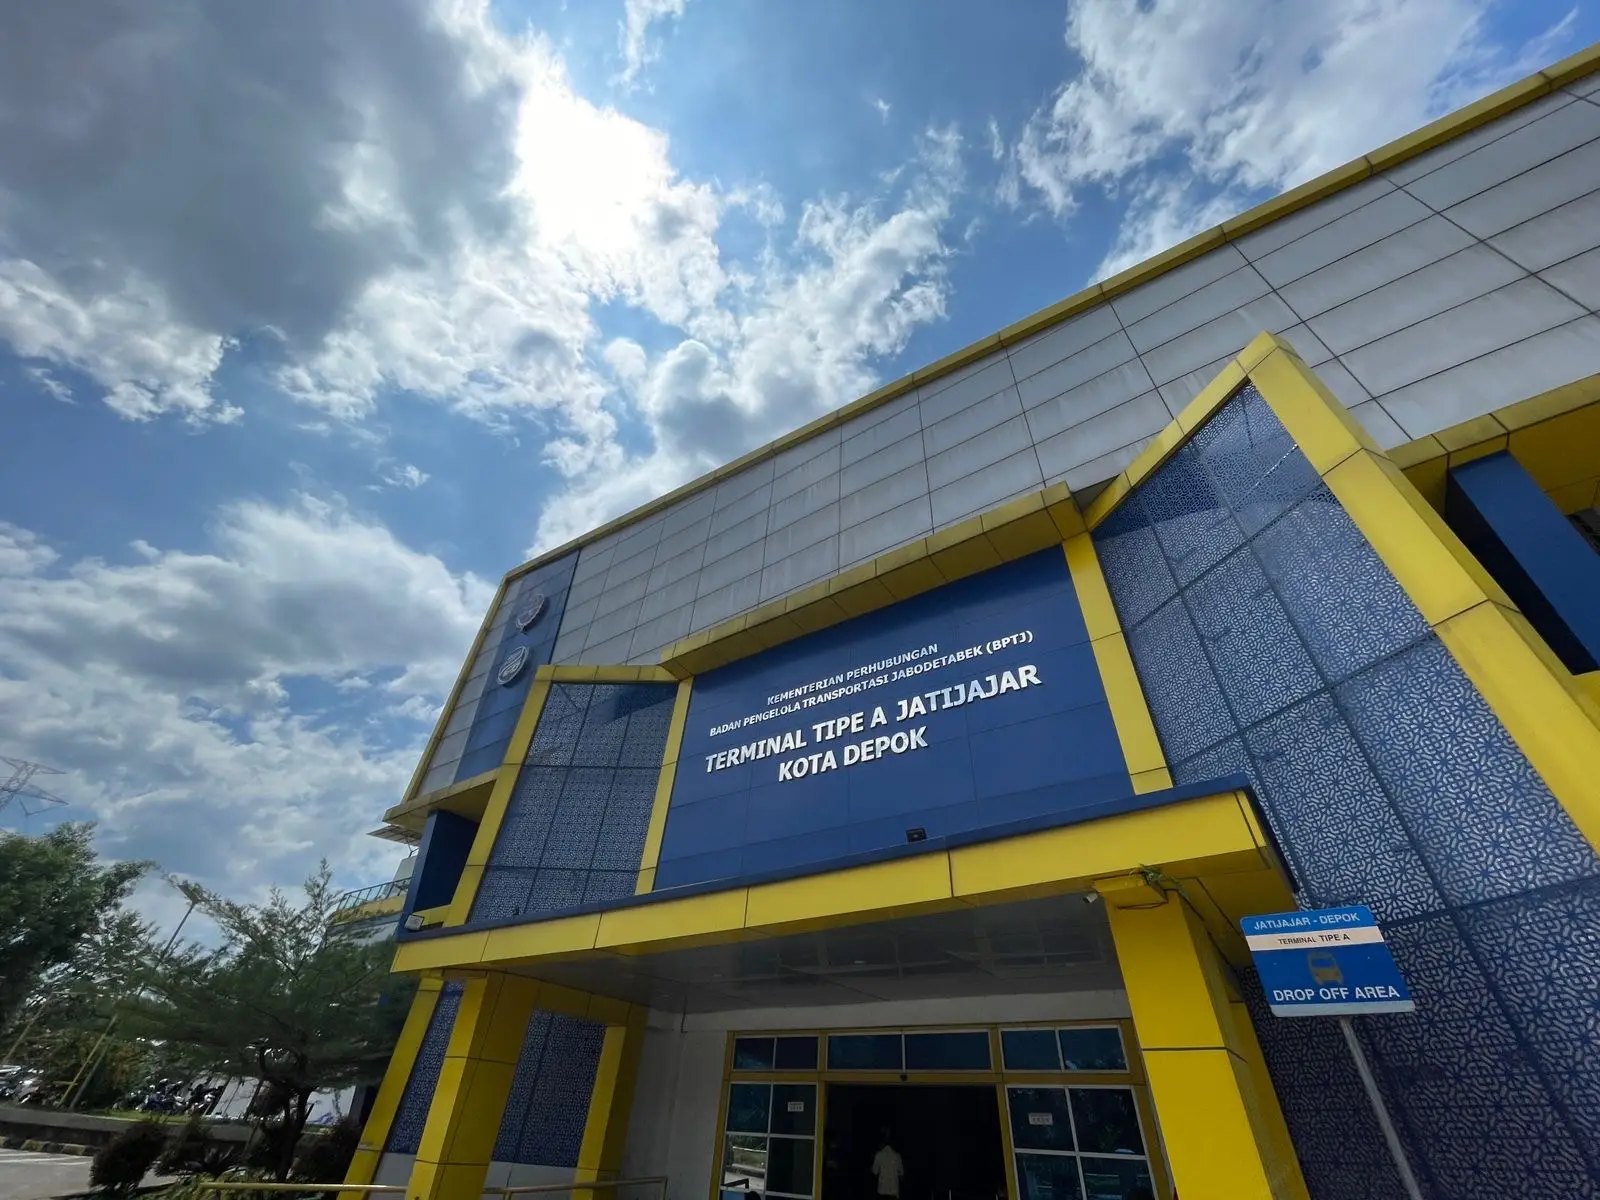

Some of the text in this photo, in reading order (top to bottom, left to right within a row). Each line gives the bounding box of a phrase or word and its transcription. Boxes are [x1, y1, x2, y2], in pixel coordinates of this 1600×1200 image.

[709, 630, 1034, 736] BADAN PENGELOLA TRANSPORTASI JABODETABEK (BPTJ)
[767, 643, 938, 706] KEMENTERIAN PERHUBUNGAN
[705, 664, 1042, 773] TERMINAL TIPE A JATIJAJAR
[778, 726, 928, 782] KOTA DEPOK
[1253, 916, 1311, 930] JATIJAJAR
[1320, 912, 1360, 925] DEPOK
[1278, 933, 1350, 945] TERMINAL TIPE A
[1273, 985, 1400, 1001] DROP OFF AREA
